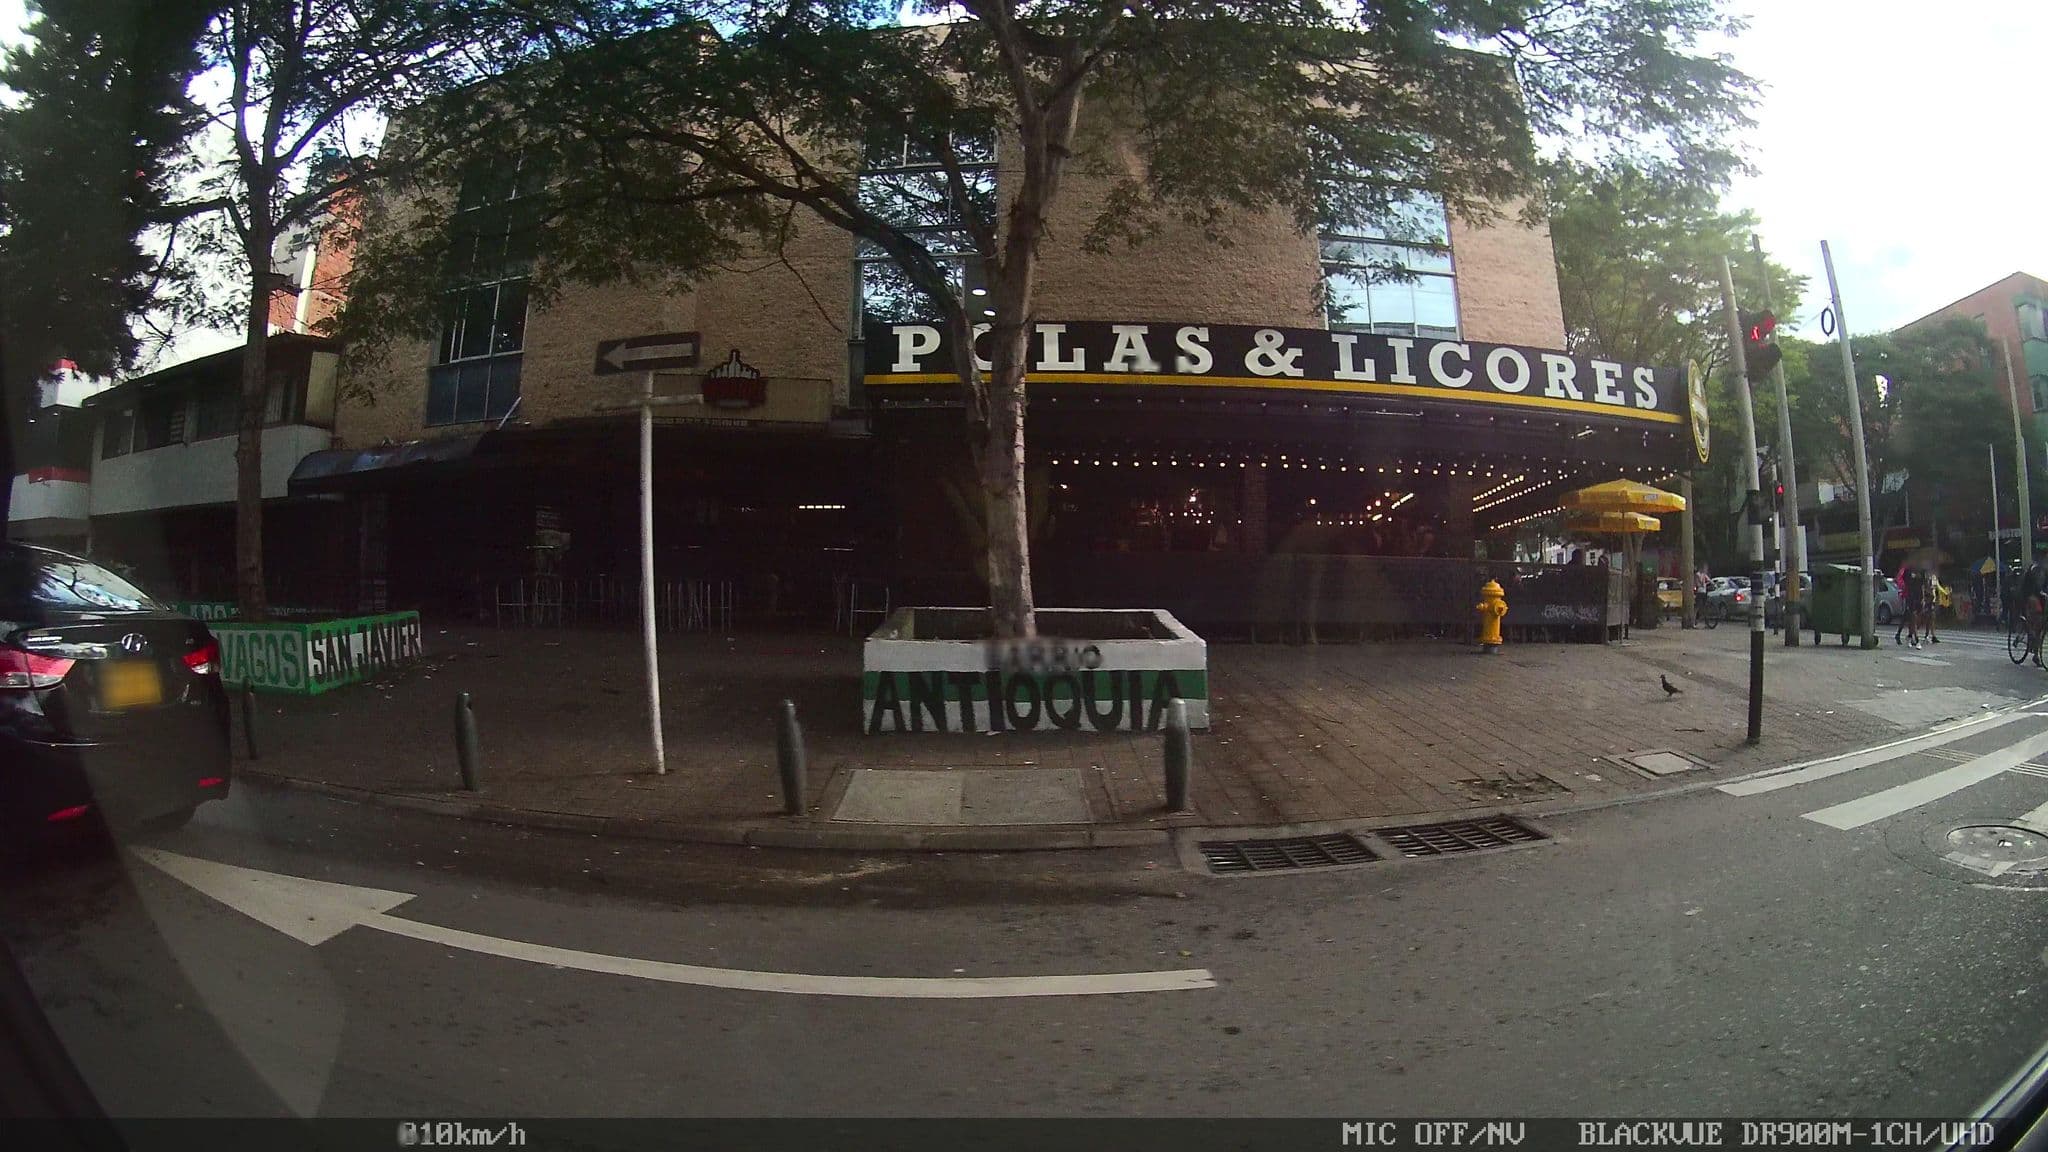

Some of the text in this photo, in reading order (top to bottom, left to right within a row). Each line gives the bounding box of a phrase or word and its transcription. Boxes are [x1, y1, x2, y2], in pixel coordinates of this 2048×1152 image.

[1244, 328, 1304, 377] &
[1330, 333, 1658, 410] LICORES
[310, 617, 423, 685] SAN JAVIER
[987, 643, 1102, 671] RRIO
[869, 670, 1183, 733] ANTIOQUIA
